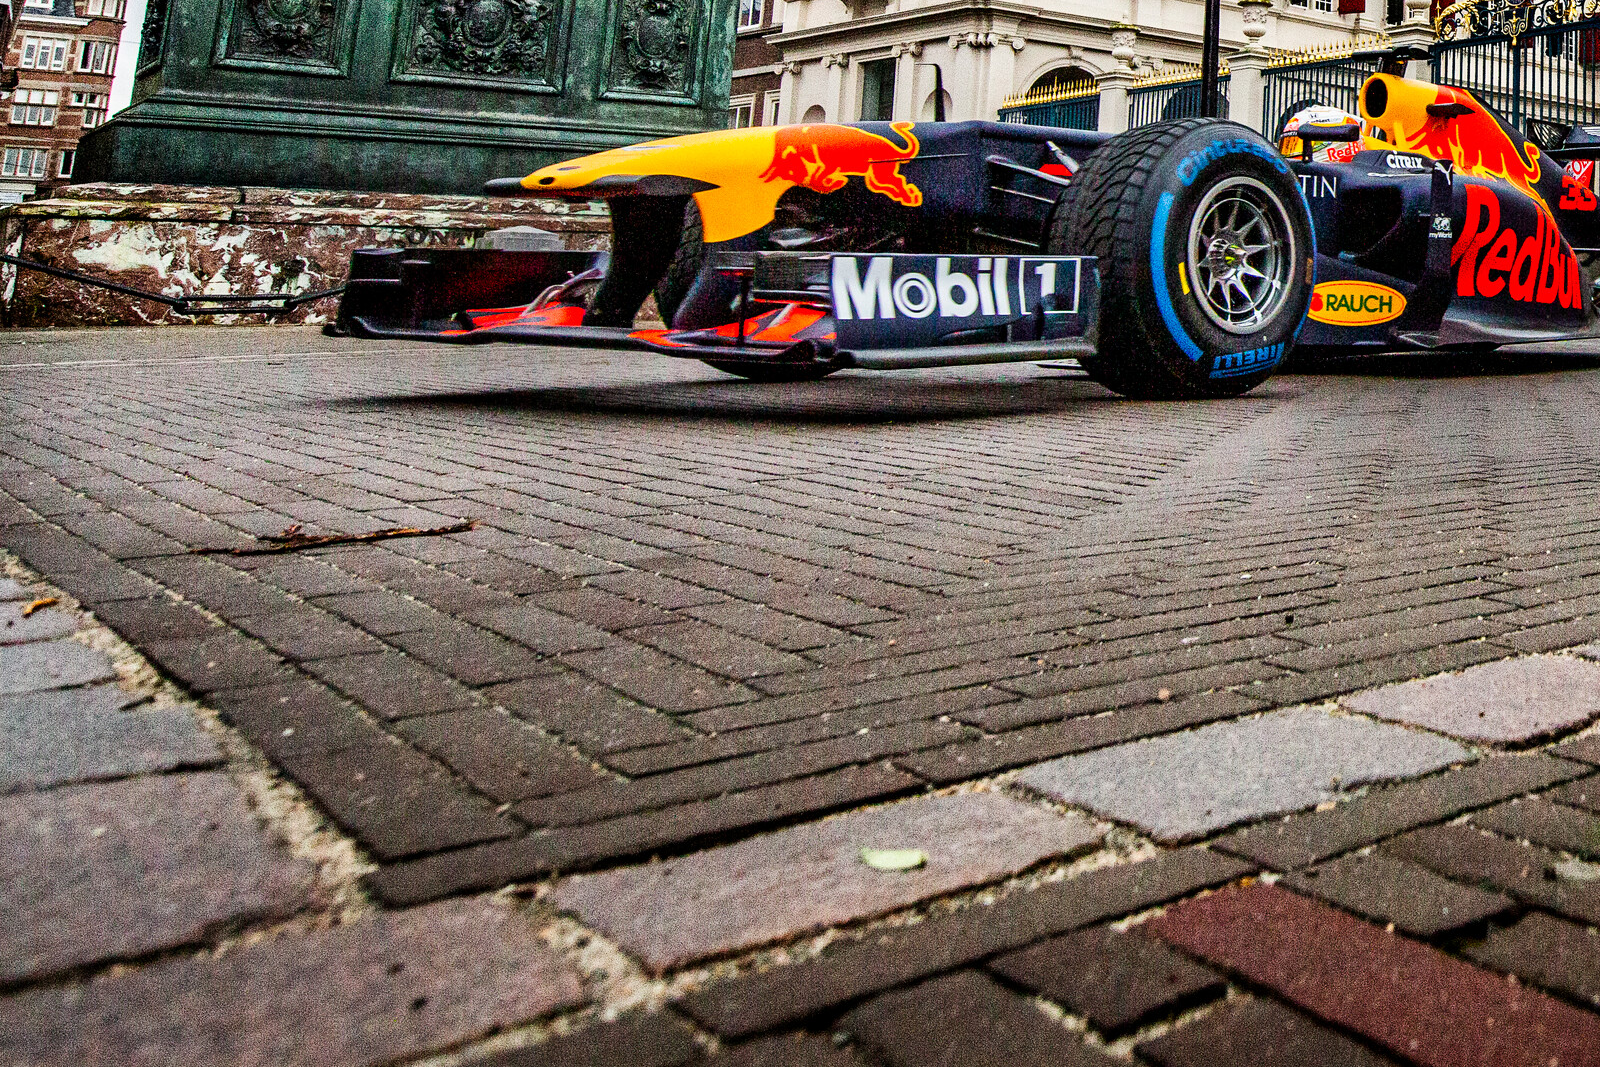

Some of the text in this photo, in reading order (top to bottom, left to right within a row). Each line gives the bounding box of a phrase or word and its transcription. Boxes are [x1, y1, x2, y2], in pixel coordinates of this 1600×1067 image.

[1298, 174, 1337, 199] TIN
[831, 256, 1012, 320] Mobil
[1325, 293, 1394, 314] RAUCH
